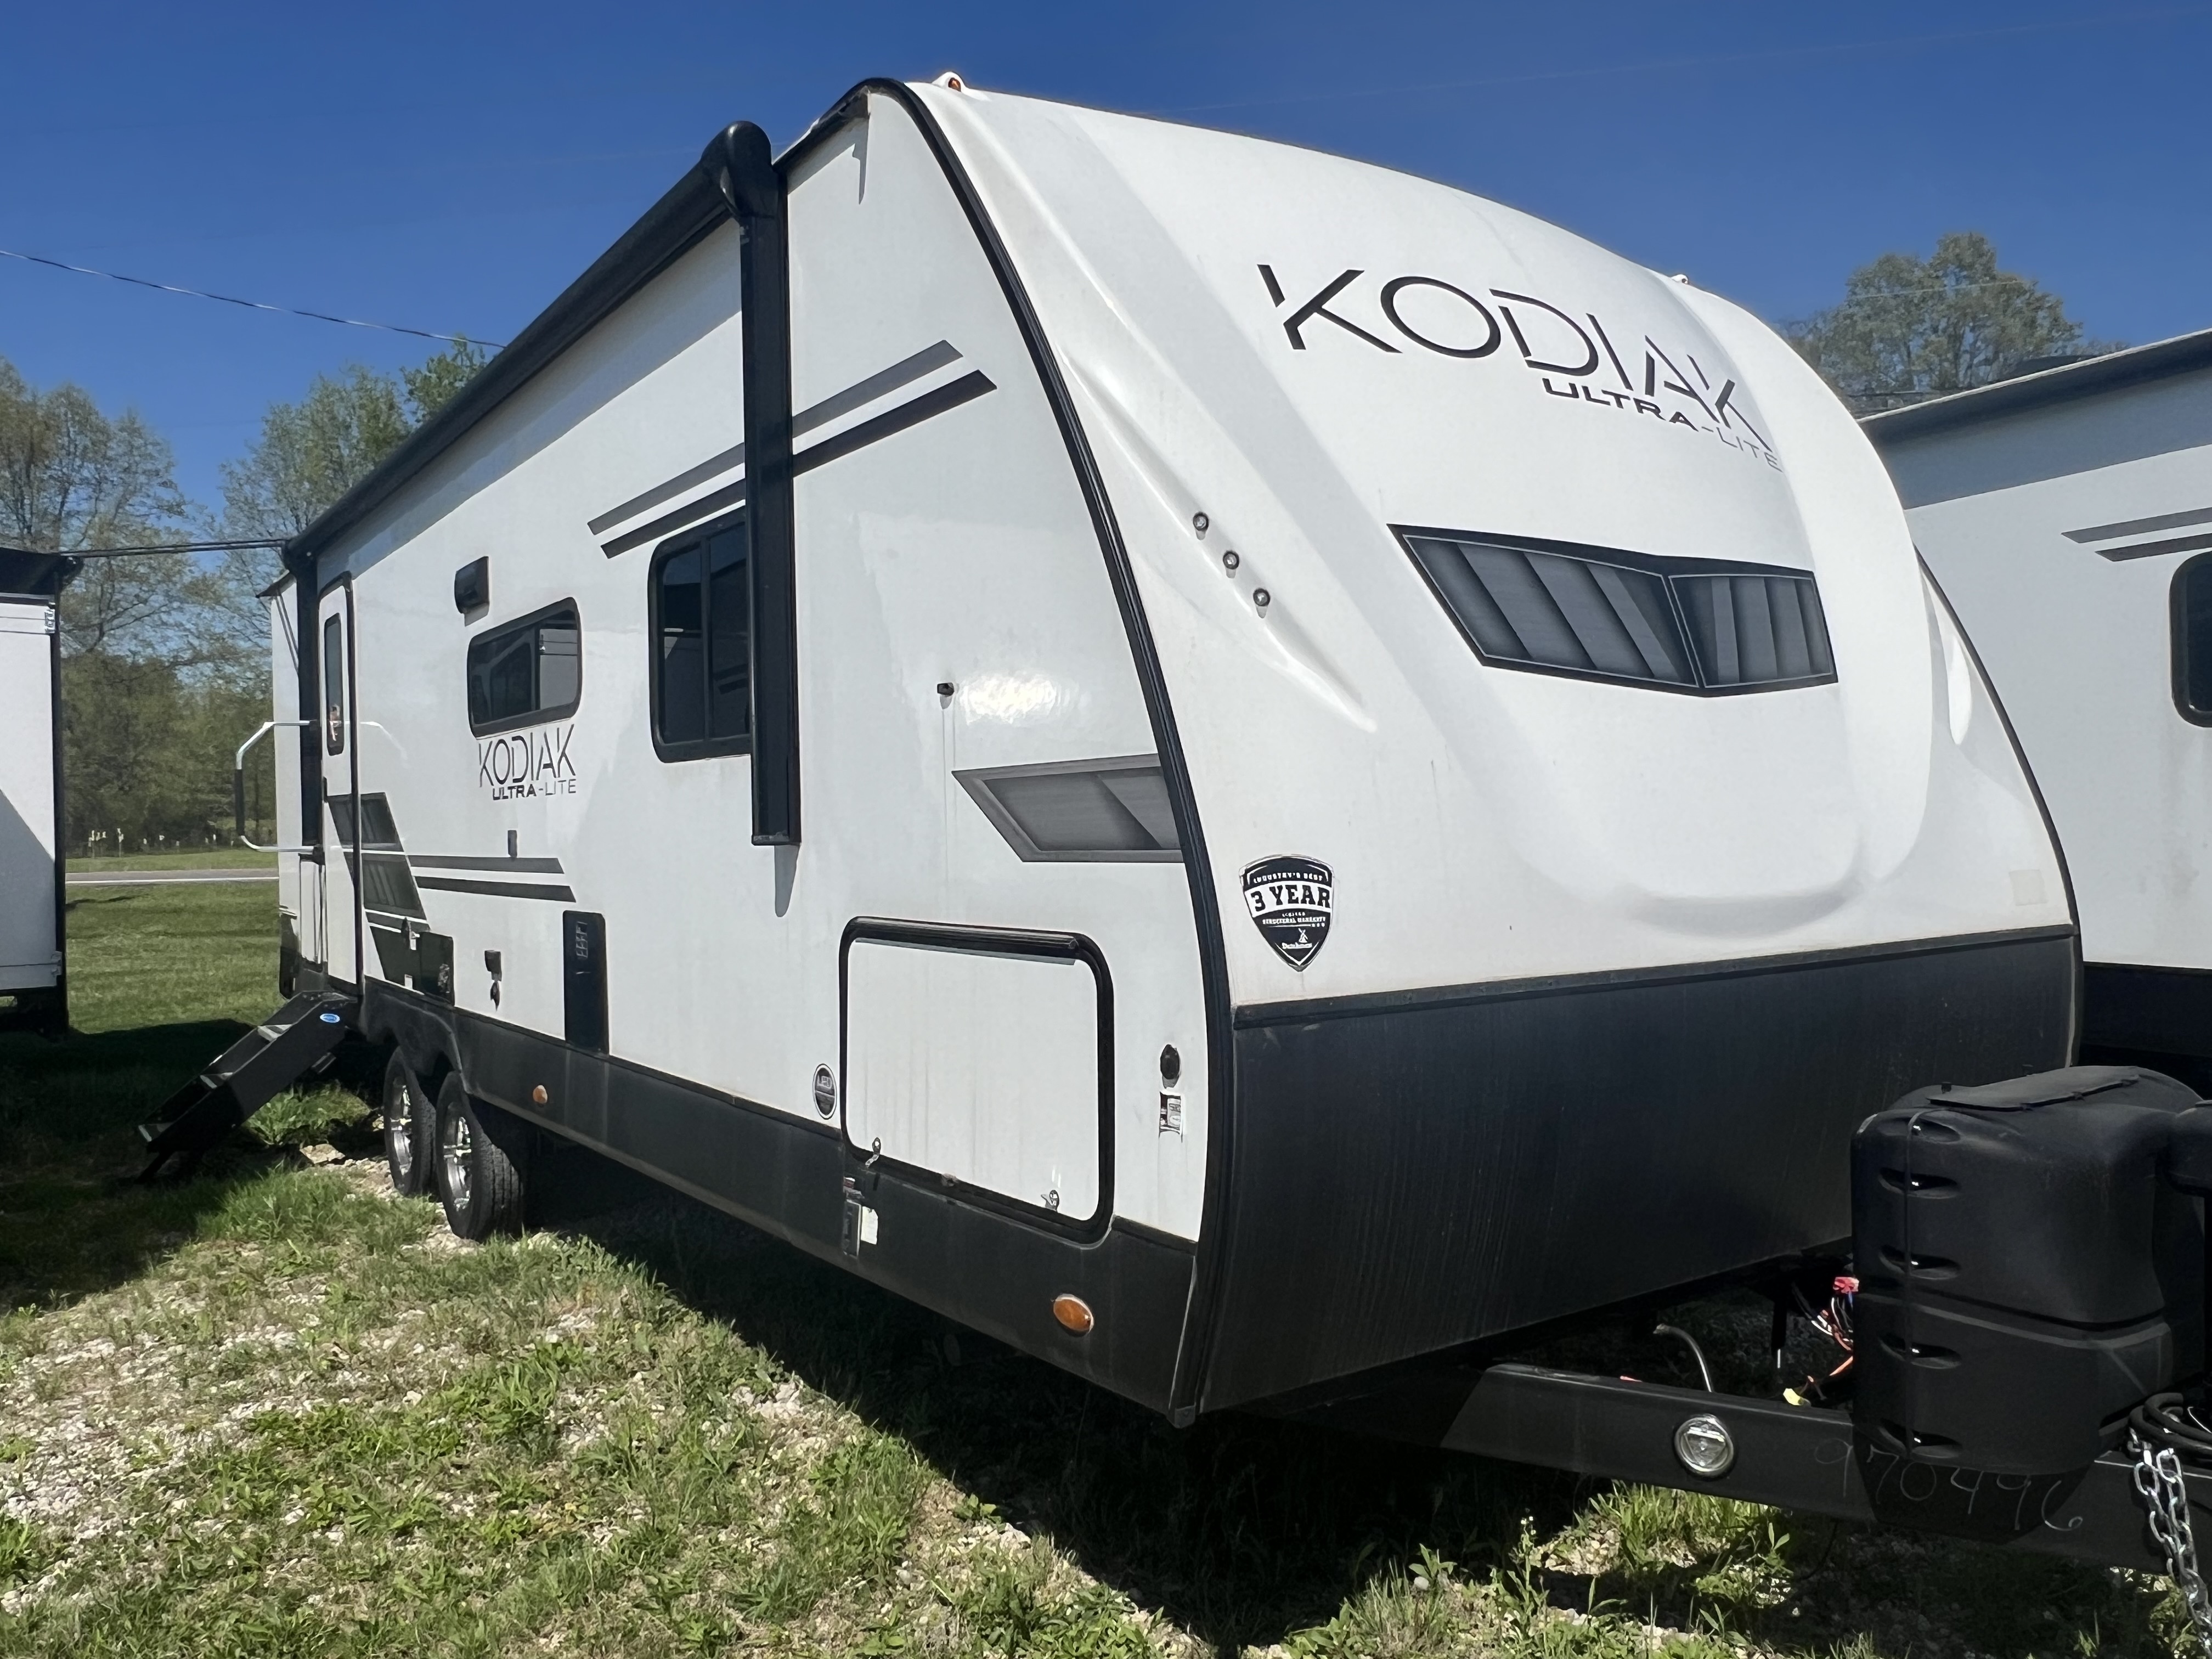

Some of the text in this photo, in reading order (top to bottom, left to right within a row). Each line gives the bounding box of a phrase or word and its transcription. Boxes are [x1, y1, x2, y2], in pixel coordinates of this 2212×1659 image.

[1257, 263, 1773, 452] KODIAK
[1542, 377, 1783, 472] ULTRA-LITE
[478, 724, 576, 788] KODIAK
[493, 778, 577, 800] ULTRA-LITE
[1250, 884, 1331, 912] 3 YEAR
